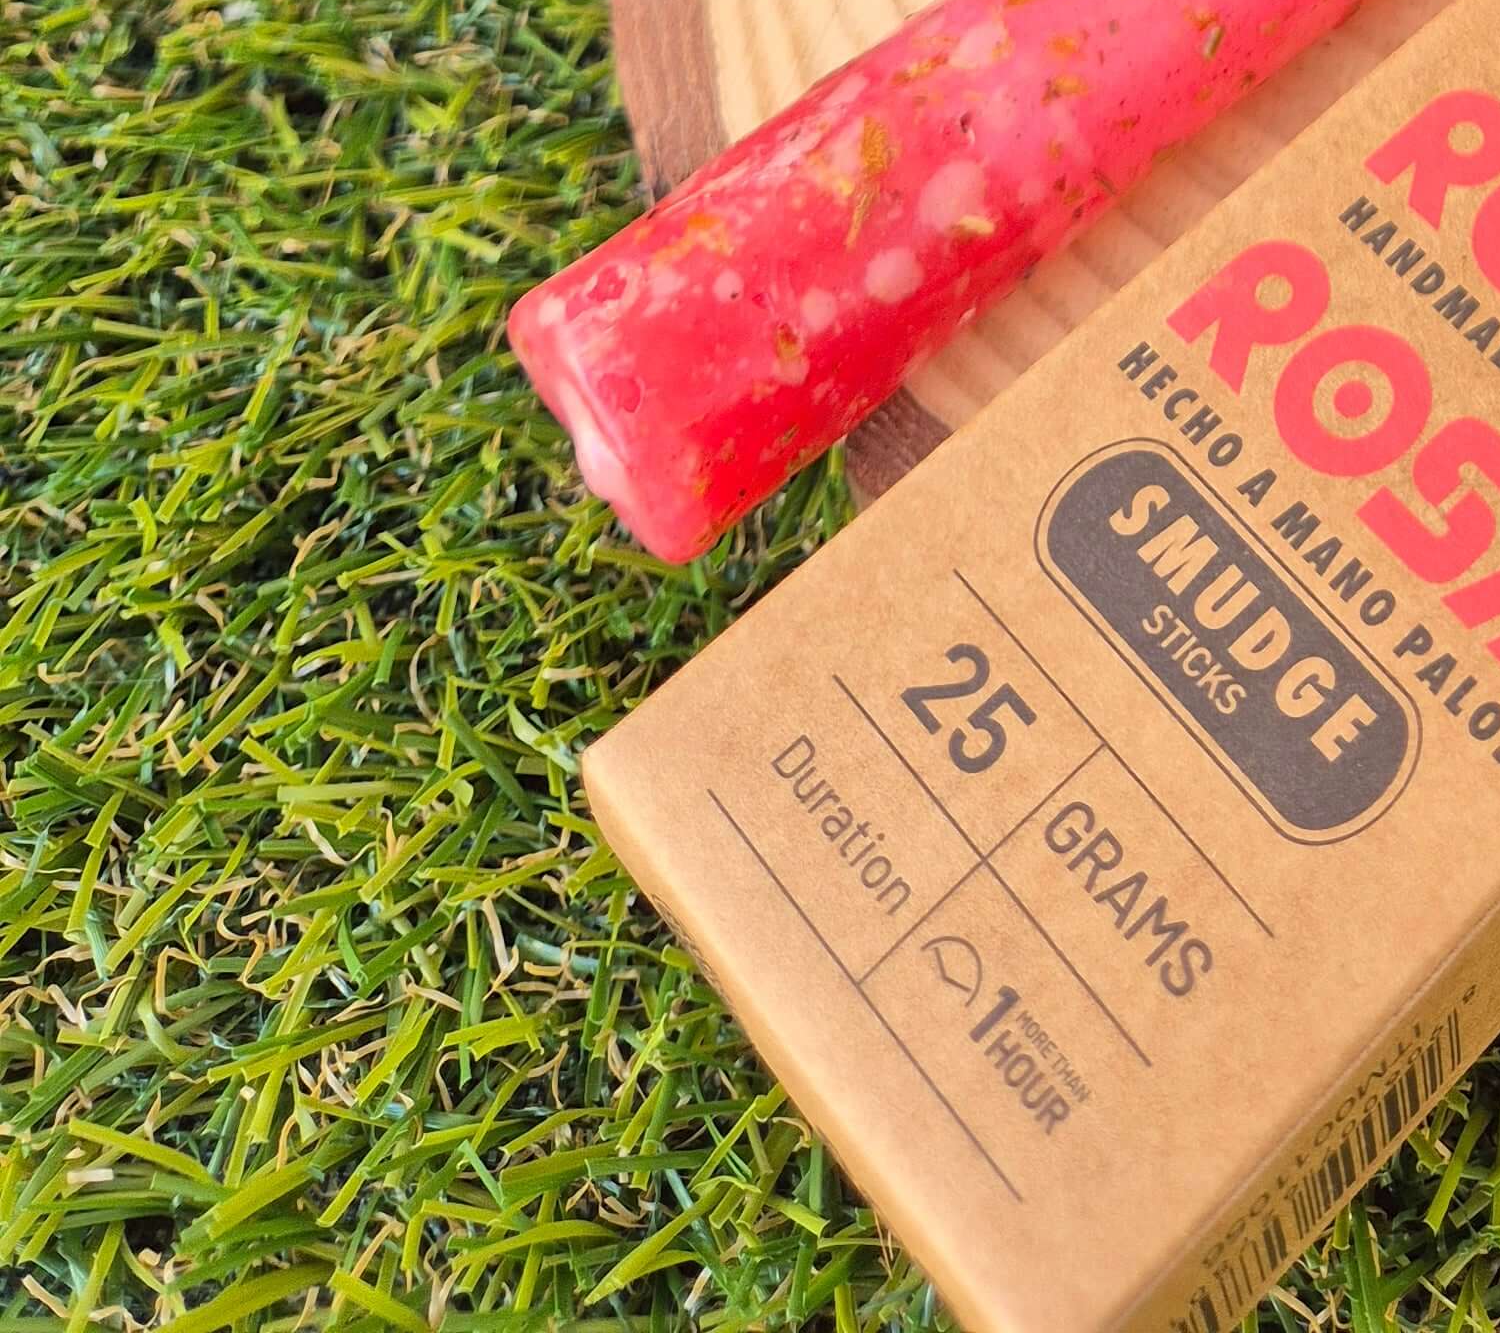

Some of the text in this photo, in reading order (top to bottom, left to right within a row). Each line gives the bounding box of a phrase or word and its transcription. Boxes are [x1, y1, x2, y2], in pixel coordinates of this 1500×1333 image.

[1116, 340, 1242, 468] HECHO
[1238, 467, 1271, 506] A
[1270, 504, 1397, 629] MANO
[1109, 484, 1381, 765] SMUDGE
[1141, 604, 1249, 716] STICKS
[900, 642, 1037, 774] 25
[771, 733, 913, 916] Duration
[1043, 800, 1213, 998] GRAMS
[969, 984, 1022, 1044] 1
[1015, 1010, 1092, 1103] MORE THAN
[983, 1029, 1071, 1136] HOUR
